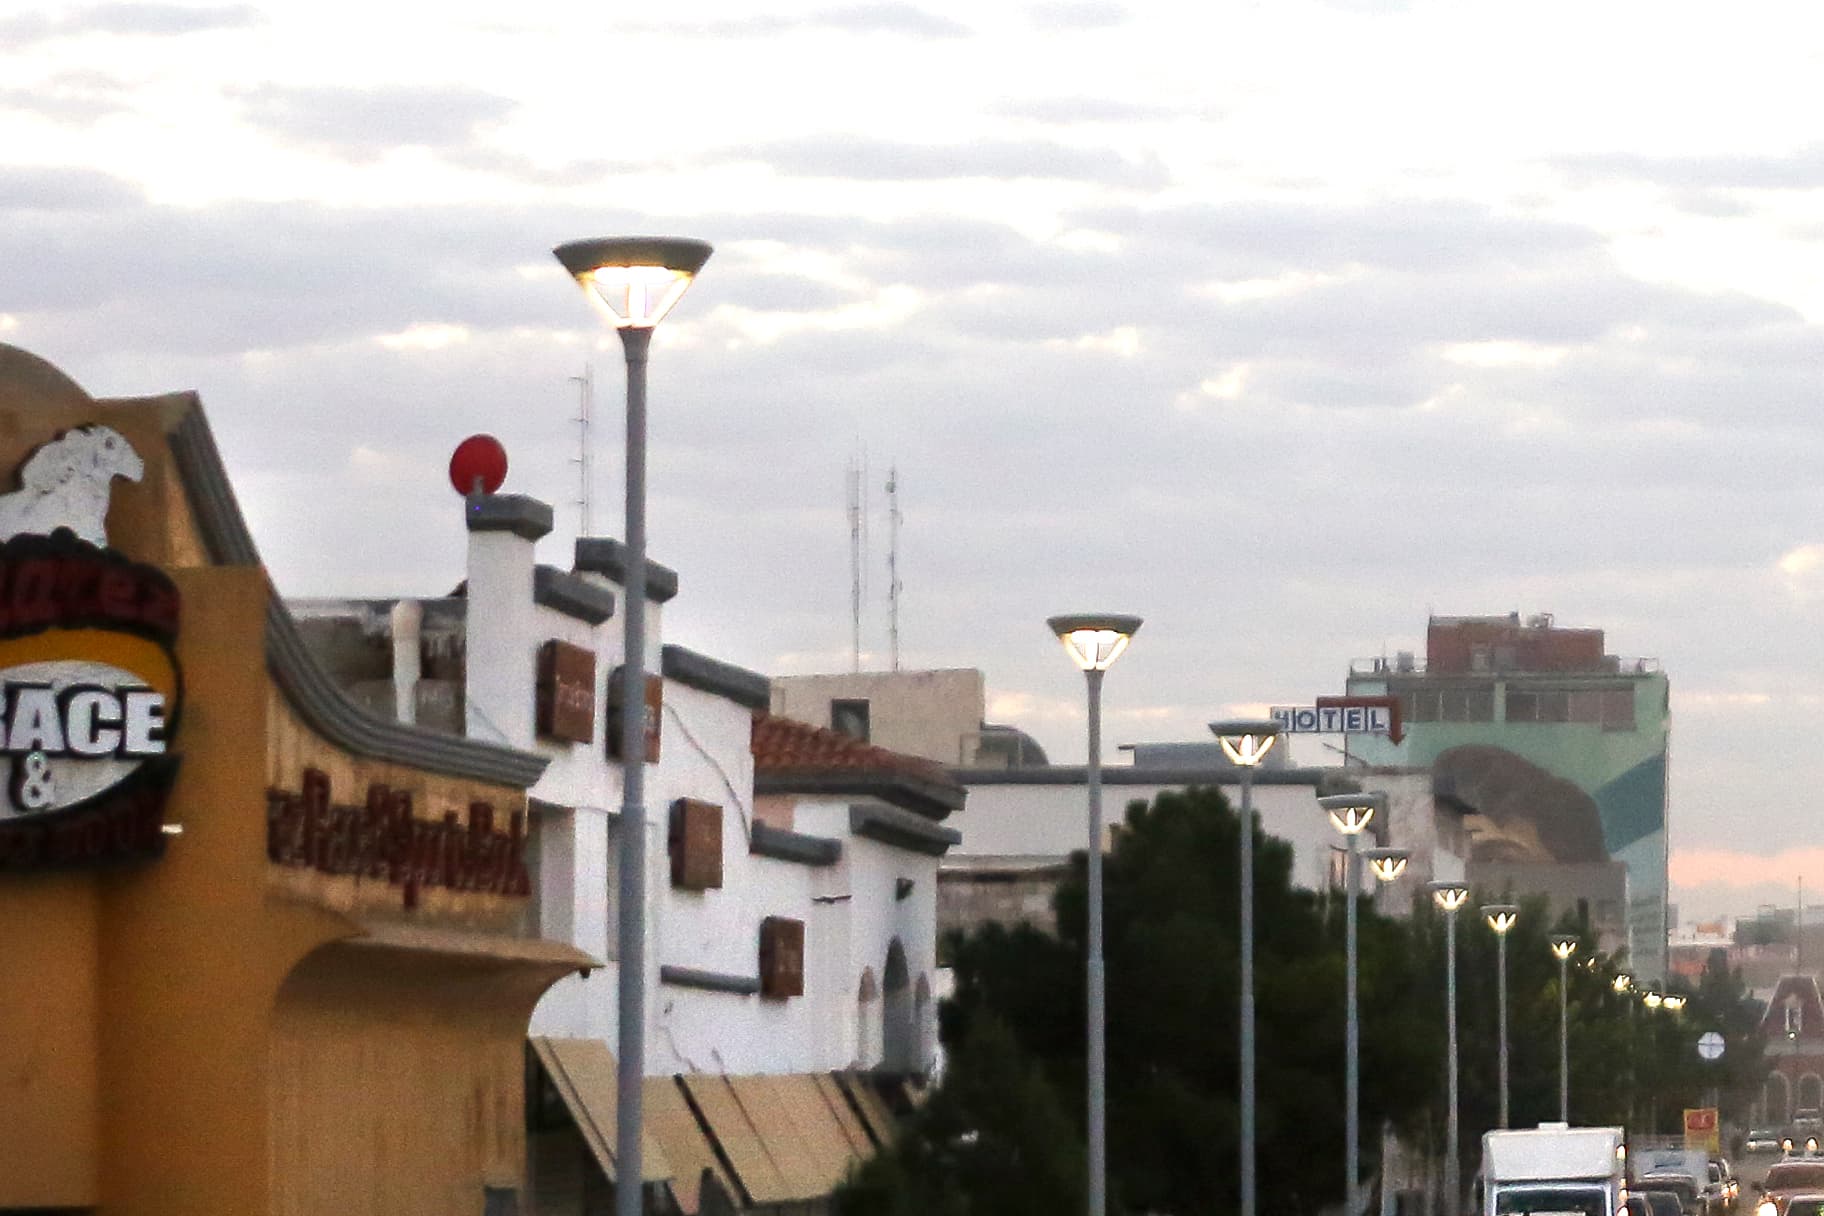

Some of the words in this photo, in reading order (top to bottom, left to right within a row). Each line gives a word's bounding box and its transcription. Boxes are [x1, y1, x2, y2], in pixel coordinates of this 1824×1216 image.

[0, 686, 167, 753] ACE
[1274, 708, 1385, 730] HOTEL
[21, 752, 52, 809] &
